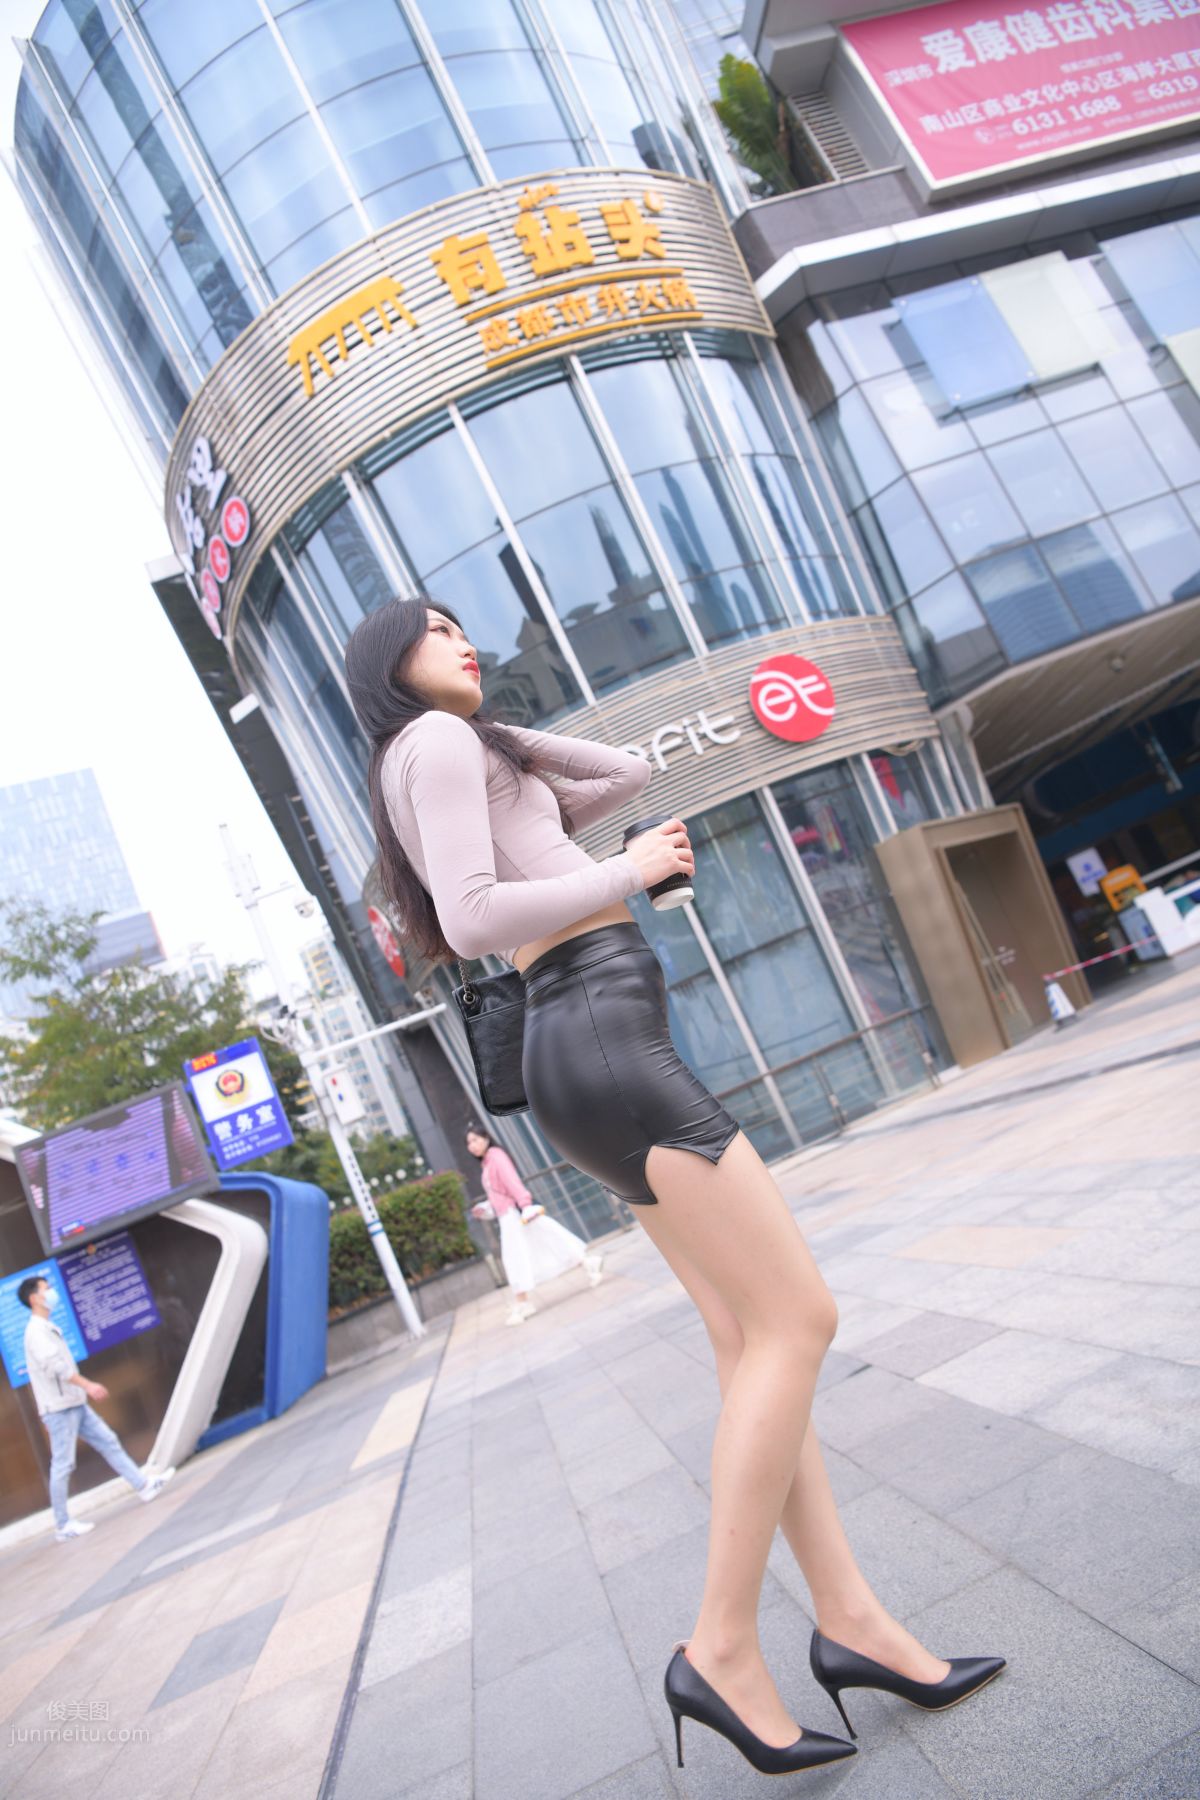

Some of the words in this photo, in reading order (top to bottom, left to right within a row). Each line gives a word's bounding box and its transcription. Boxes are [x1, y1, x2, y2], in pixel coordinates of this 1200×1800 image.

[1012, 108, 1067, 135] 6131
[1067, 94, 1122, 122] 1688
[1147, 75, 1198, 100] 6319
[479, 277, 699, 355] 成都市井火锅
